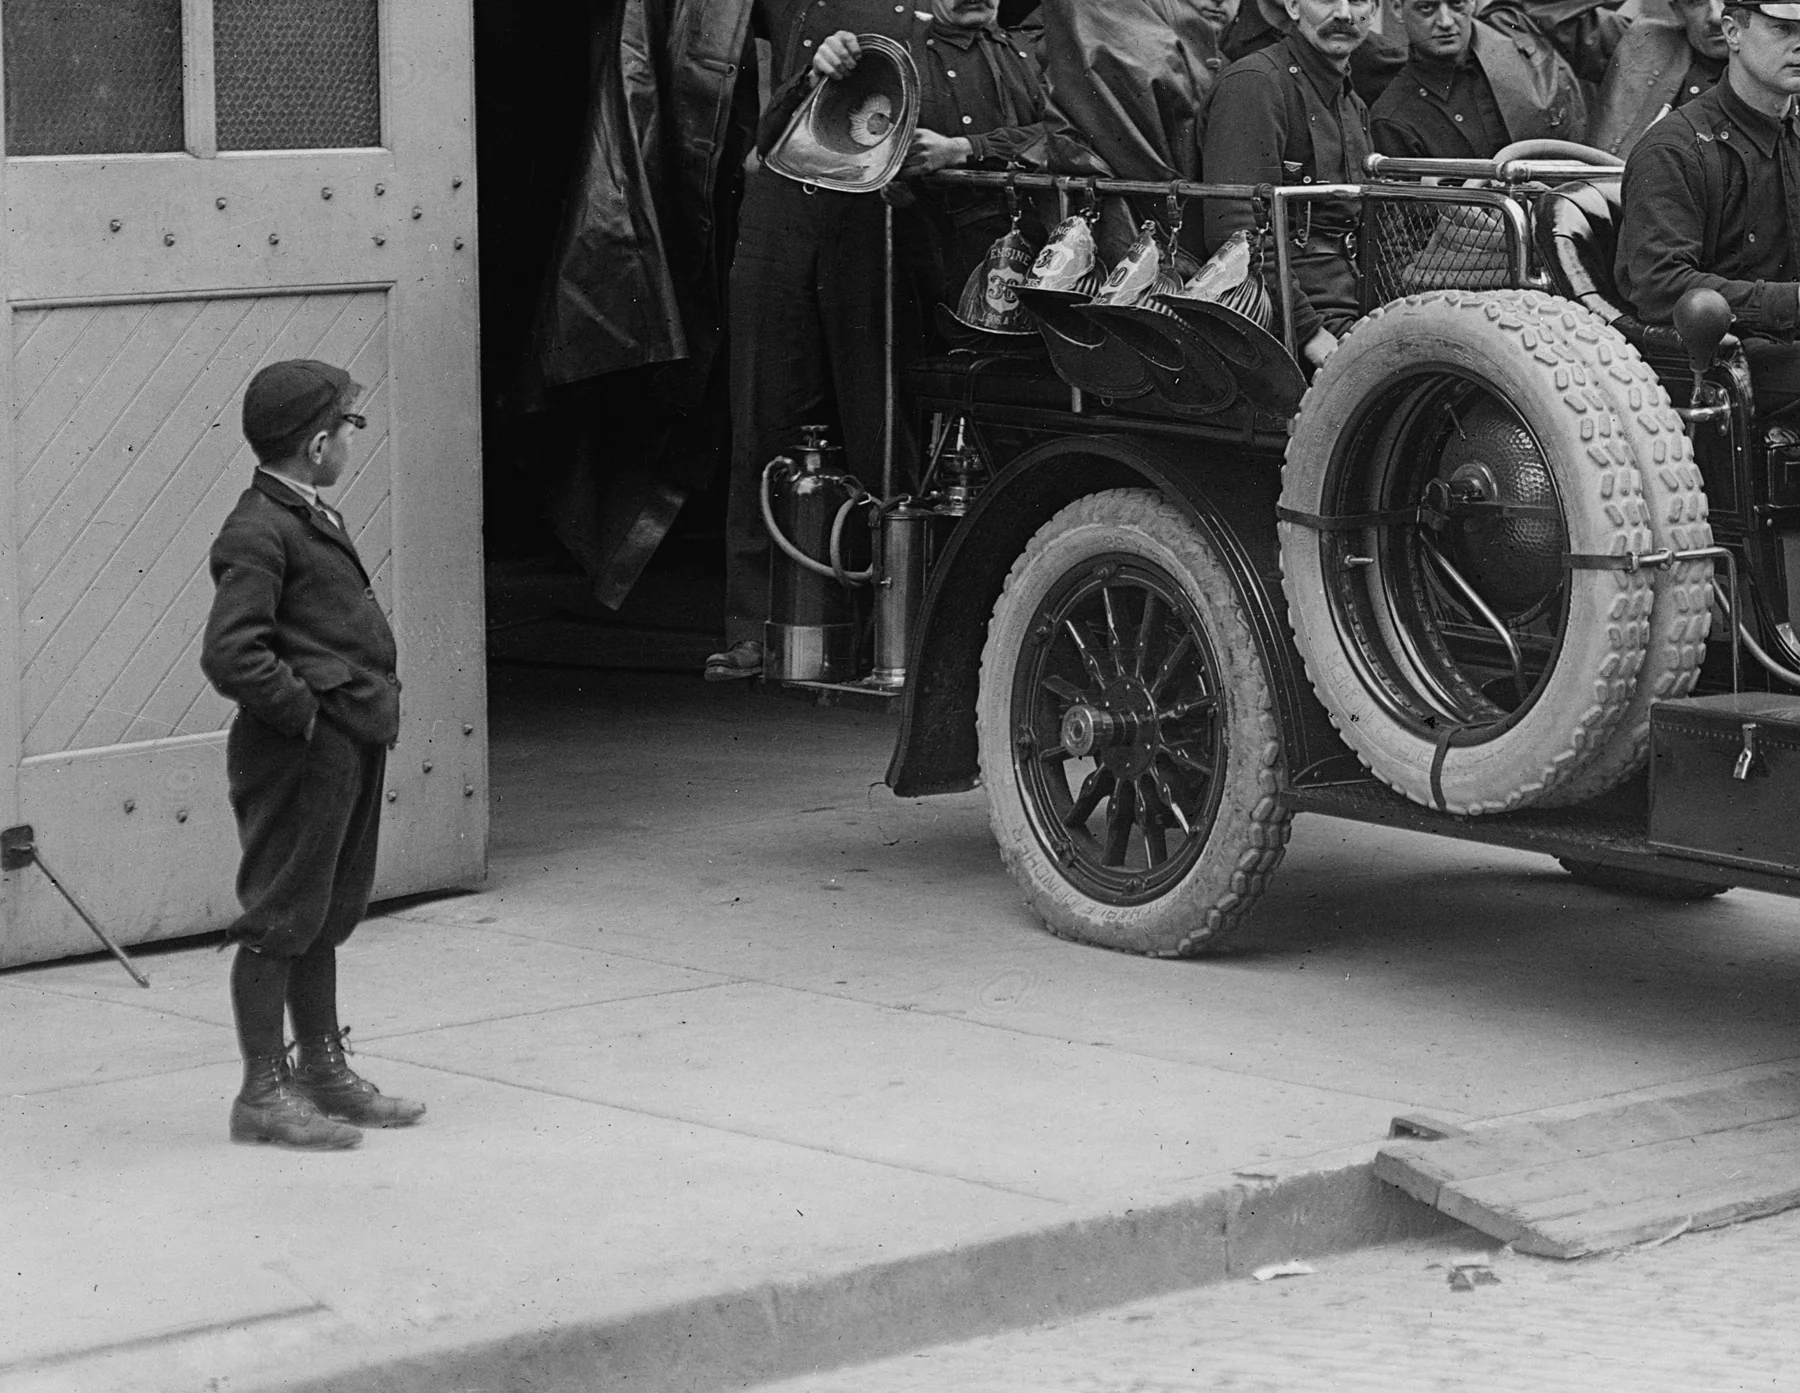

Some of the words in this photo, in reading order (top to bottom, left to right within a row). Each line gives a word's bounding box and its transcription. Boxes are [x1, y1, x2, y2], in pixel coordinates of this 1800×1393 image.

[990, 247, 1032, 266] ENGINE
[1035, 248, 1068, 270] 30
[988, 274, 1019, 304] 30
